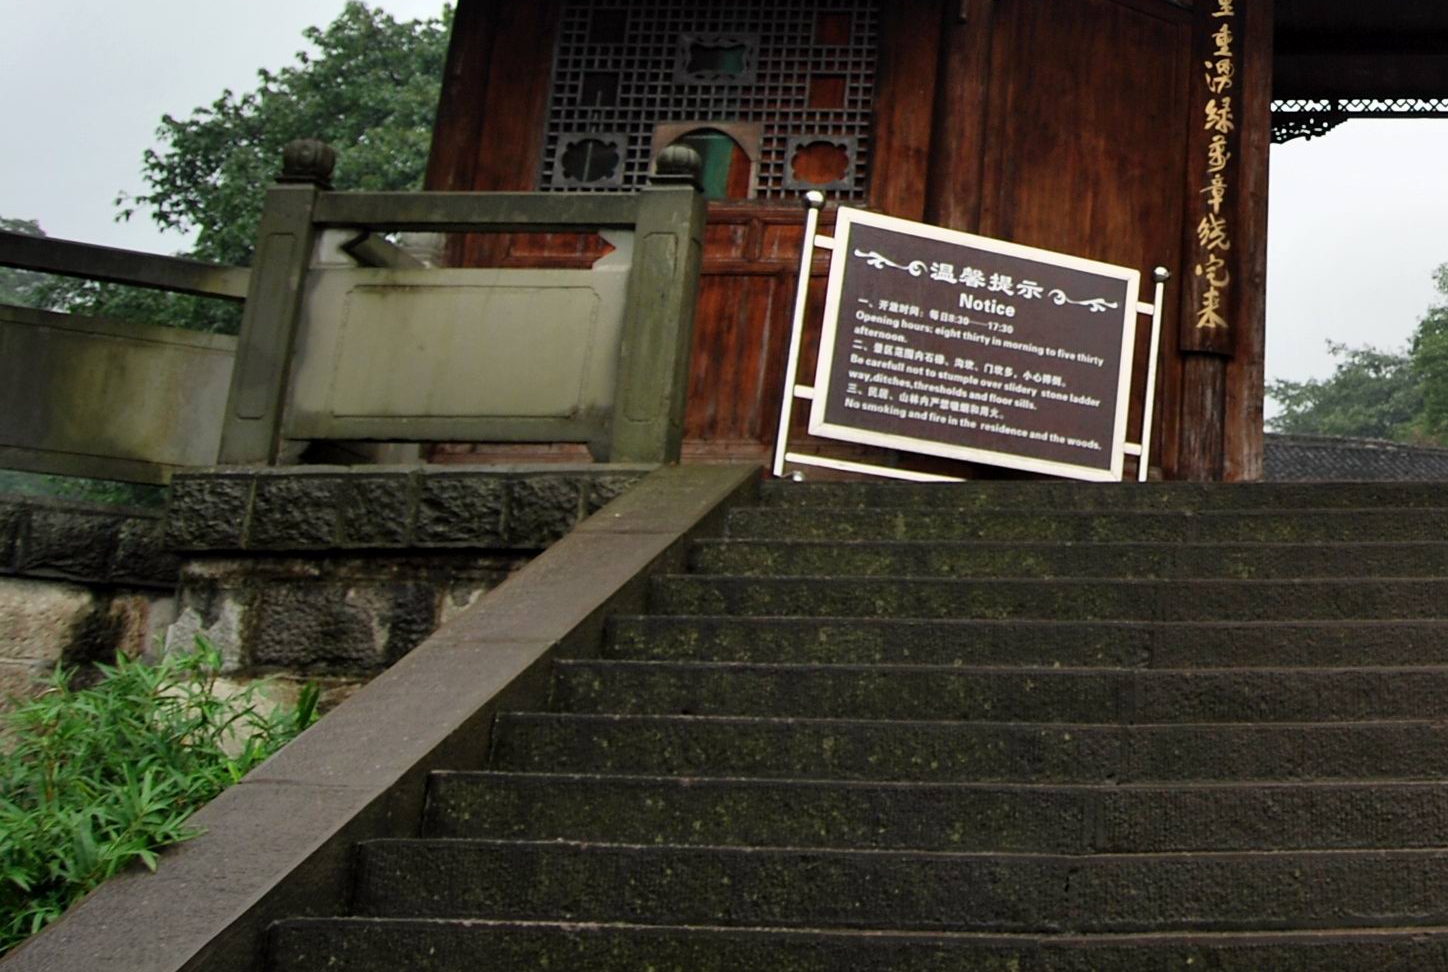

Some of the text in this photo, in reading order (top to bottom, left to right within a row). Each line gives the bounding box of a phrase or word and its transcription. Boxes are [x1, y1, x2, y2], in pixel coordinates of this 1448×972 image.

[930, 262, 1044, 299] 温馨提示
[958, 292, 1016, 318] Notice
[853, 325, 909, 344] afternoon.
[855, 309, 900, 329] Opening
[934, 326, 962, 341] eight
[962, 330, 991, 346] thirty
[991, 335, 1002, 347] in
[1003, 340, 1044, 356] morning
[1045, 347, 1057, 356] to
[1057, 348, 1076, 361] five
[1076, 352, 1105, 368] thirty
[849, 353, 864, 365] Be
[905, 365, 924, 376] not
[924, 368, 937, 379] to
[980, 379, 1003, 390] over
[1040, 389, 1069, 403] stone
[1068, 393, 1102, 408] ladder
[968, 391, 988, 402] and
[988, 393, 1014, 406] floor
[844, 397, 861, 410] No
[861, 402, 908, 419] smoking
[907, 410, 929, 422] and
[928, 412, 948, 425] fire
[947, 415, 959, 427] in
[959, 417, 978, 430] the
[980, 422, 1029, 439] residence
[1028, 430, 1050, 442] and
[1049, 433, 1066, 445] the
